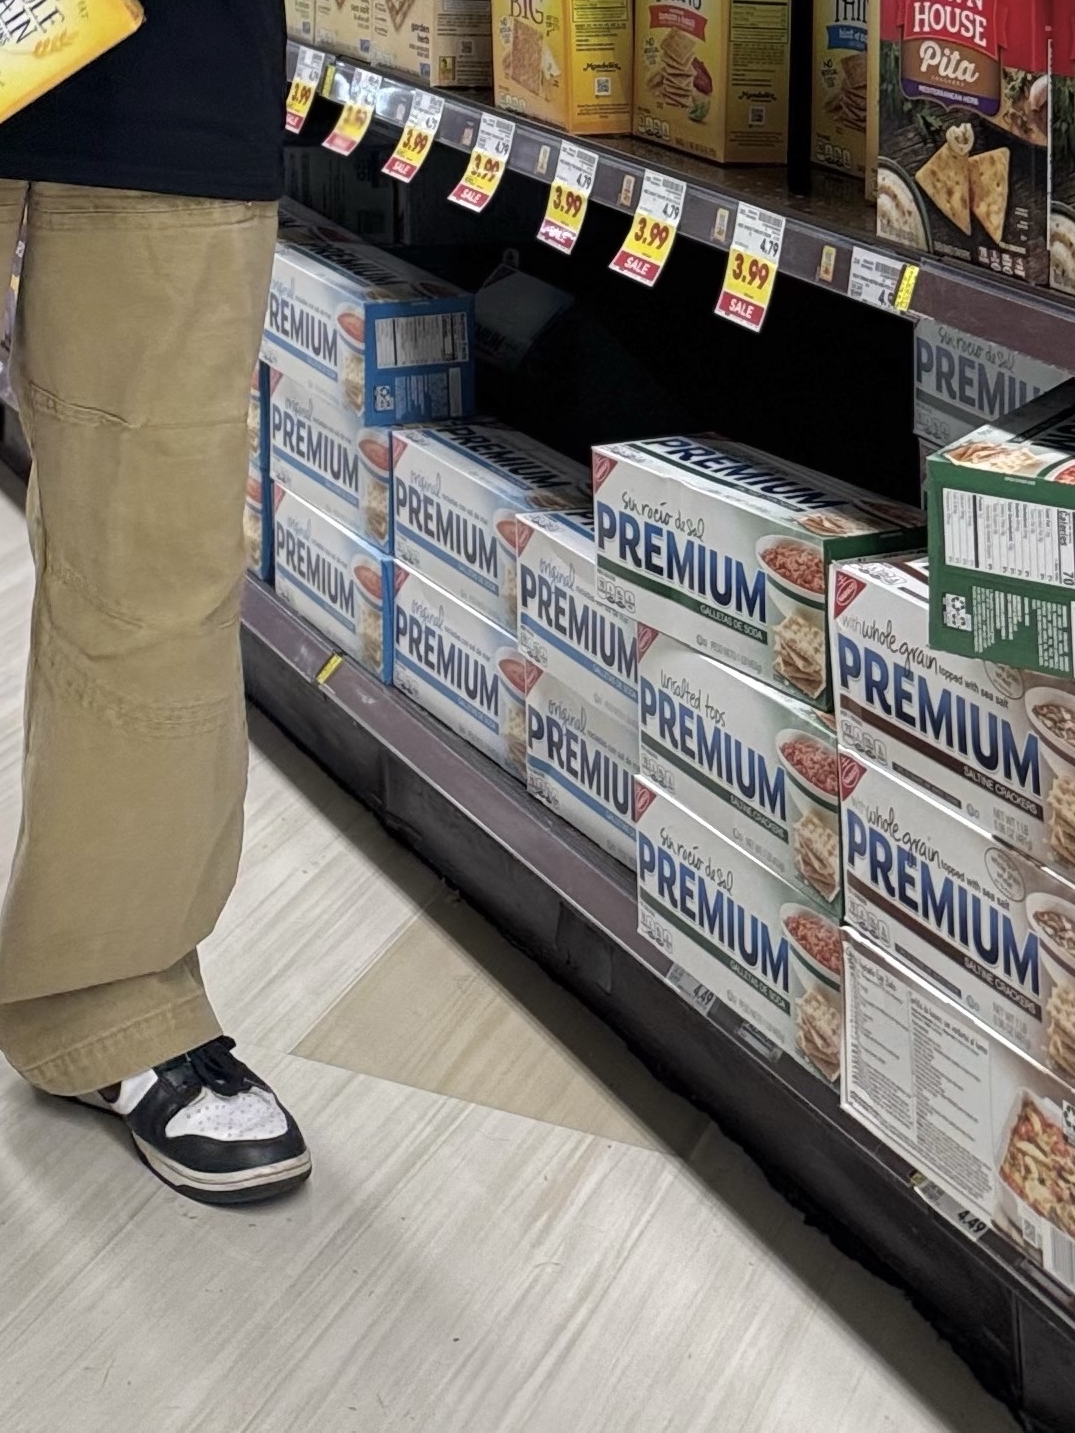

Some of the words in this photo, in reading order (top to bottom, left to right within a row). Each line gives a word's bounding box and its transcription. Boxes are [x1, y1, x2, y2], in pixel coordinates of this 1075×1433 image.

[913, 2, 988, 48] HOUSE
[919, 40, 980, 84] Pita
[291, 82, 312, 107] 3.99
[402, 129, 430, 154] 3.99
[393, 161, 411, 175] SALE
[460, 188, 482, 205] SALE
[552, 184, 583, 219] 3.99
[662, 201, 680, 221] 4.79
[633, 216, 670, 251] 3.99
[759, 238, 780, 259] 4.79
[625, 255, 651, 276] SALE
[731, 252, 770, 291] 3.99
[269, 291, 338, 367] REMIUM
[729, 297, 756, 319] SALE
[272, 403, 359, 493] PREMIUM
[448, 426, 572, 489] PREMIUM
[410, 468, 442, 499] original
[654, 437, 850, 510] PREMIUM
[395, 476, 498, 579] PREMIUM
[1058, 509, 1069, 547] Calories
[276, 520, 355, 618] PREMIUM
[539, 556, 577, 591] original
[596, 500, 767, 624] PREMIUM
[410, 599, 445, 632] original
[520, 563, 638, 684] PREMIUM
[700, 604, 733, 625] GALLETAS
[734, 617, 743, 630] DE
[743, 621, 764, 641] SODA
[395, 604, 499, 717] PREMIUM
[842, 615, 862, 633] with
[862, 618, 897, 655] whole
[898, 642, 939, 677] grain
[938, 664, 963, 686] topped
[964, 678, 979, 694] with
[980, 687, 994, 701] sea
[995, 694, 1010, 710] salt
[548, 699, 589, 737] original
[703, 694, 727, 728] tops
[838, 632, 1042, 797] PREMIUM
[640, 675, 787, 823] PREMIUM
[963, 765, 995, 791] SALTINE
[994, 781, 1038, 816] CRACKERS
[865, 806, 903, 844] whole
[902, 831, 941, 869] grain
[846, 807, 1040, 997] PREMIUM
[940, 859, 965, 881] topped
[966, 875, 981, 893] with
[982, 886, 996, 900] sea
[996, 895, 1011, 911] salt
[638, 830, 789, 993] PREMIUM
[693, 980, 713, 1005] 4.49
[729, 958, 757, 988] GALLETAS
[757, 982, 769, 997] DE
[768, 988, 786, 1010] SODA
[964, 955, 996, 984] SALTINE
[994, 976, 1037, 1016] CRACKERS
[956, 1208, 987, 1235] 4.49
